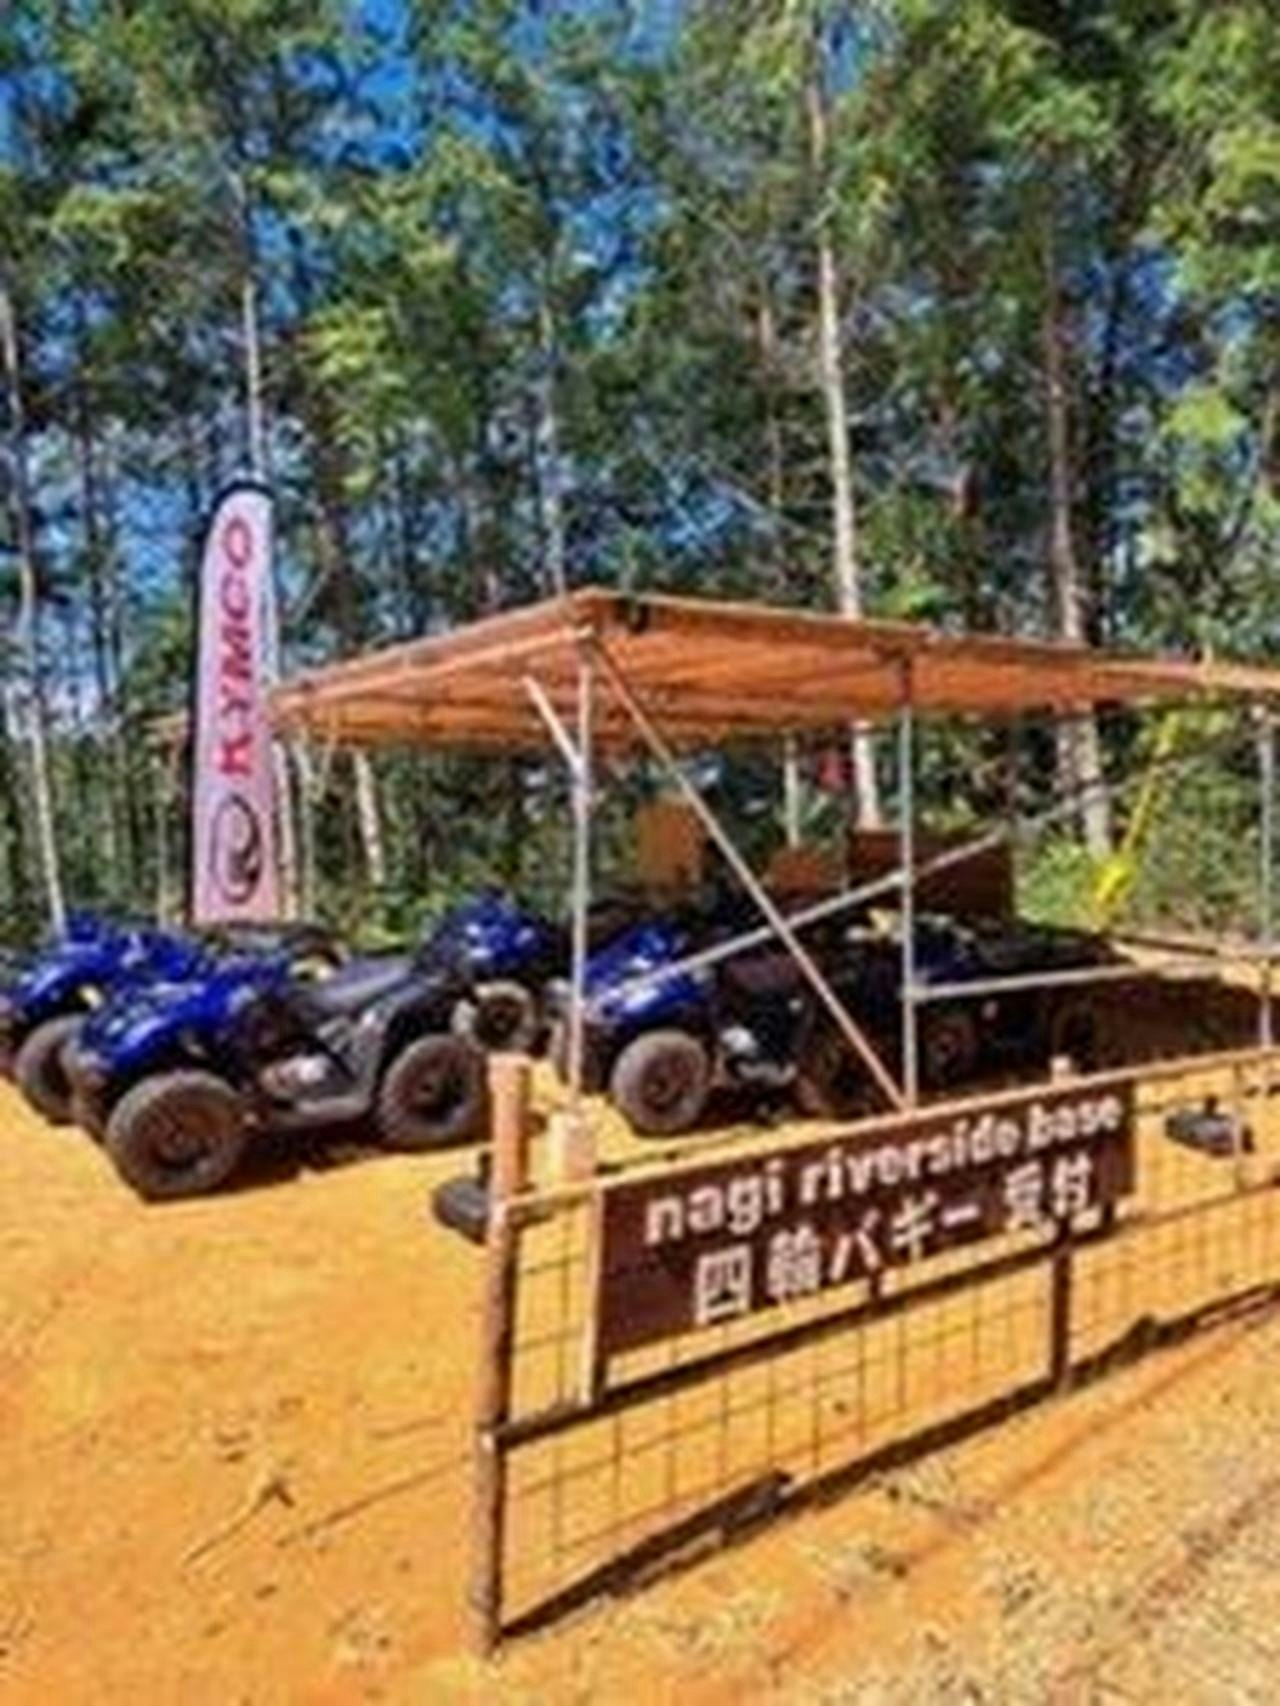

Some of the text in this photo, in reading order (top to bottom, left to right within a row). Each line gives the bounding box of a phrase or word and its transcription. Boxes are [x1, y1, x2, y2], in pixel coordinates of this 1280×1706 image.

[221, 518, 251, 775] KYMCO
[645, 1095, 1124, 1244] nagi riverside base
